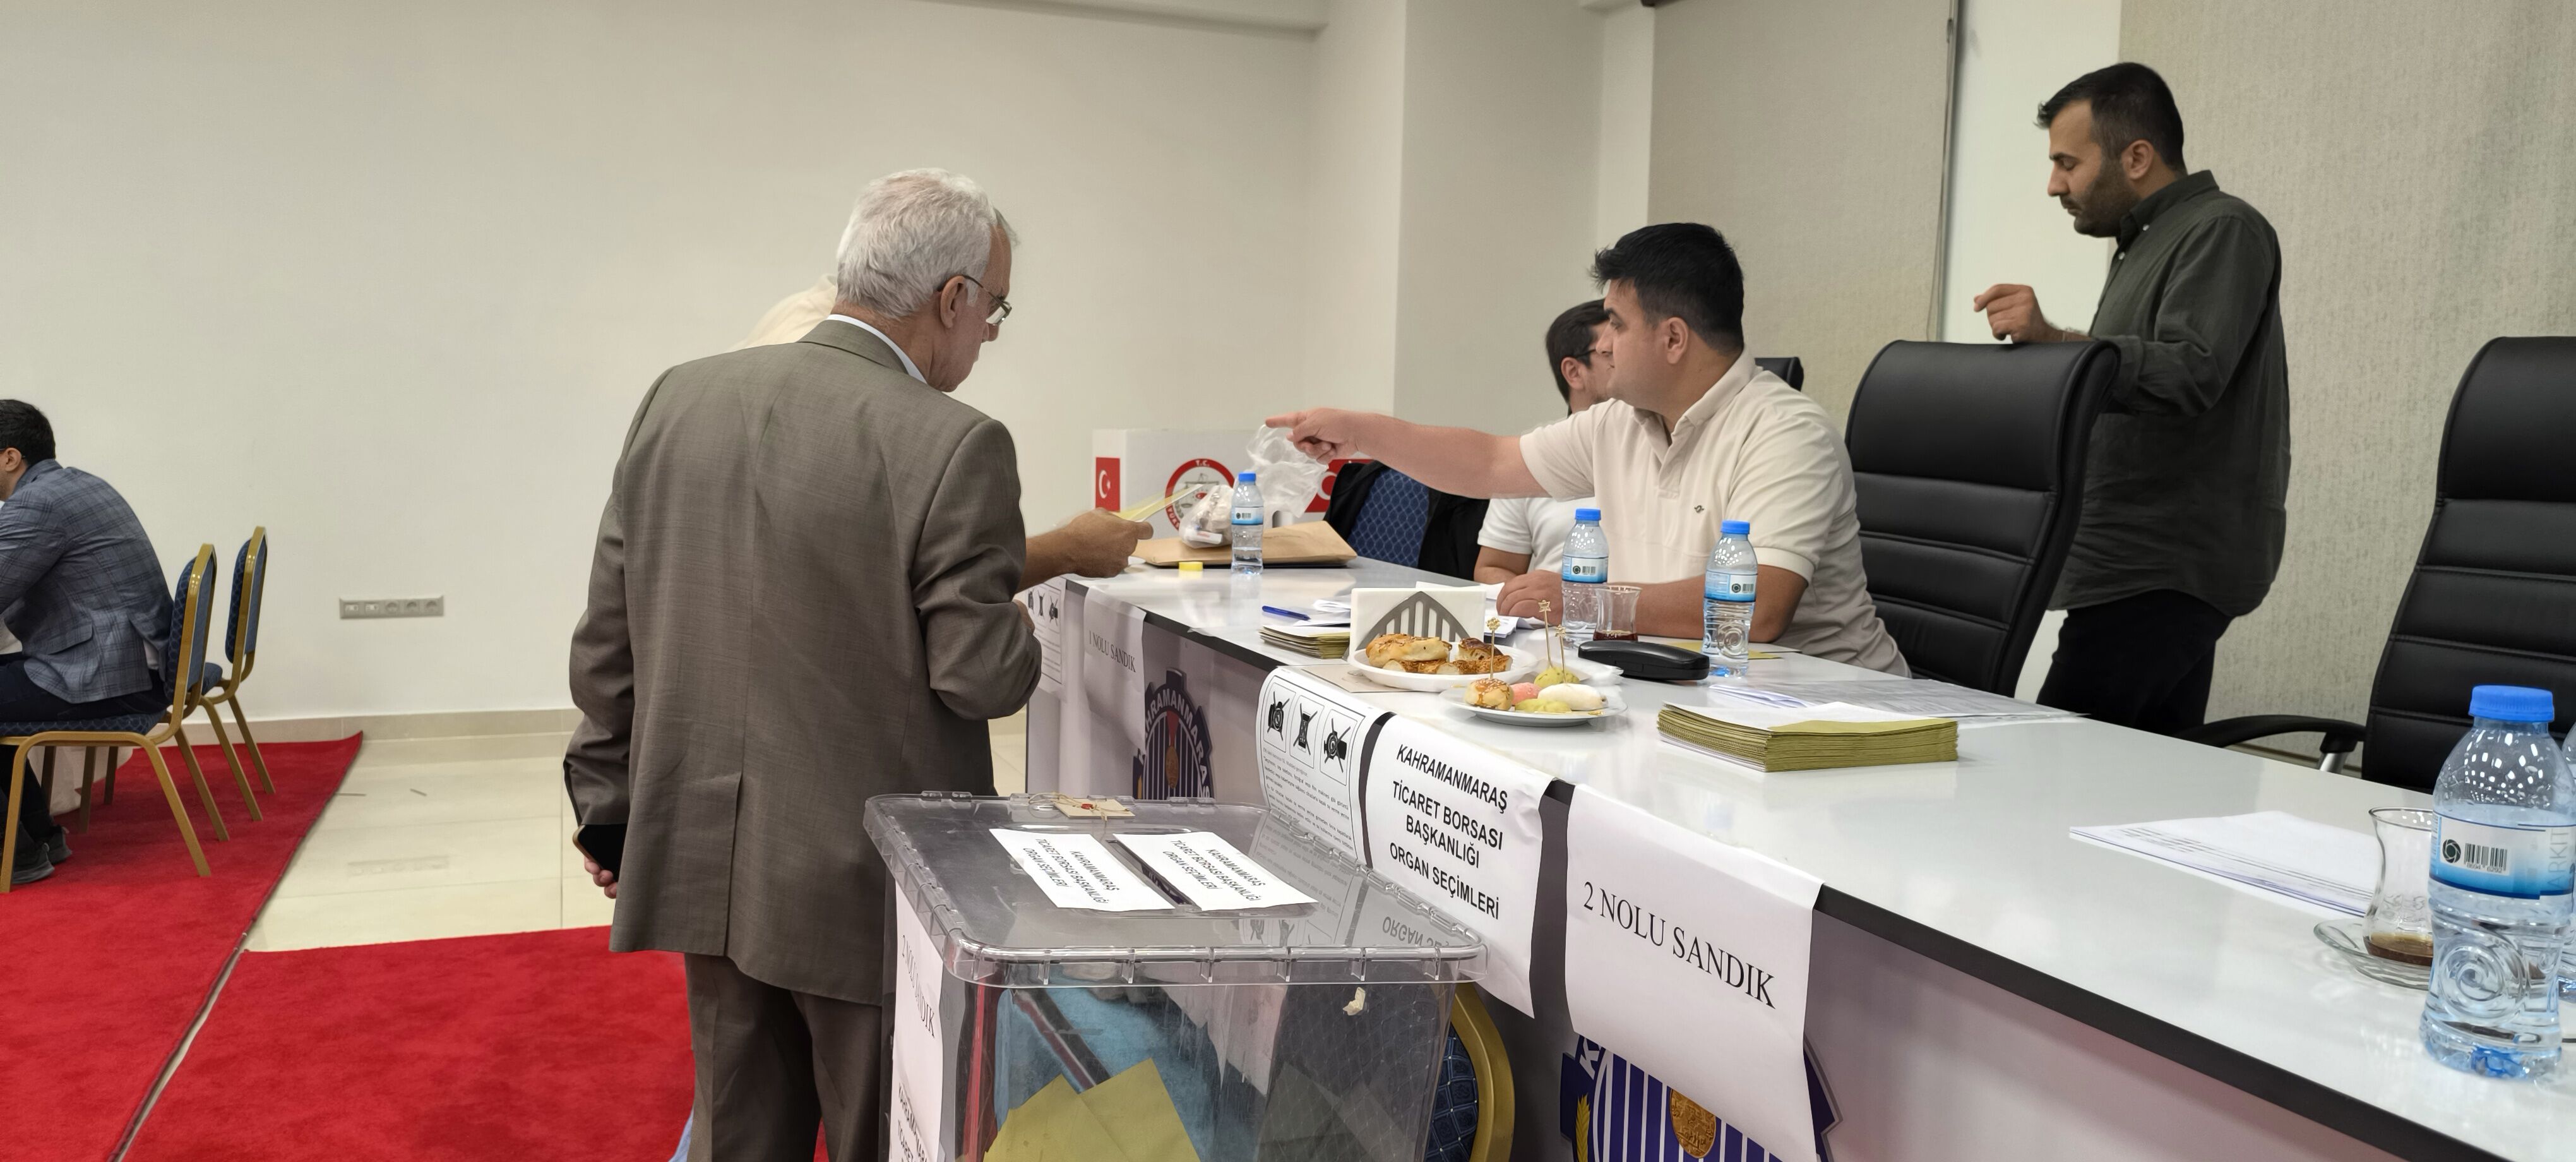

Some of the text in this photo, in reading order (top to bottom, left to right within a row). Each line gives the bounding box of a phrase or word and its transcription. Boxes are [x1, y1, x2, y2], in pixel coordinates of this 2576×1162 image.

[1092, 632, 1109, 656] NOLU
[1111, 644, 1136, 673] SANDIK
[1396, 744, 1508, 814] KAHRAMANMARAŞ
[1393, 779, 1440, 819] TİCARET
[1443, 806, 1503, 850] BORSASI
[1406, 815, 1479, 868] BAŞKANLIĞI
[1390, 842, 1429, 879] ORGAN
[1433, 867, 1499, 919] SEÇİMLERİ
[1583, 882, 1776, 1010] 2 NOLU SANDIK
